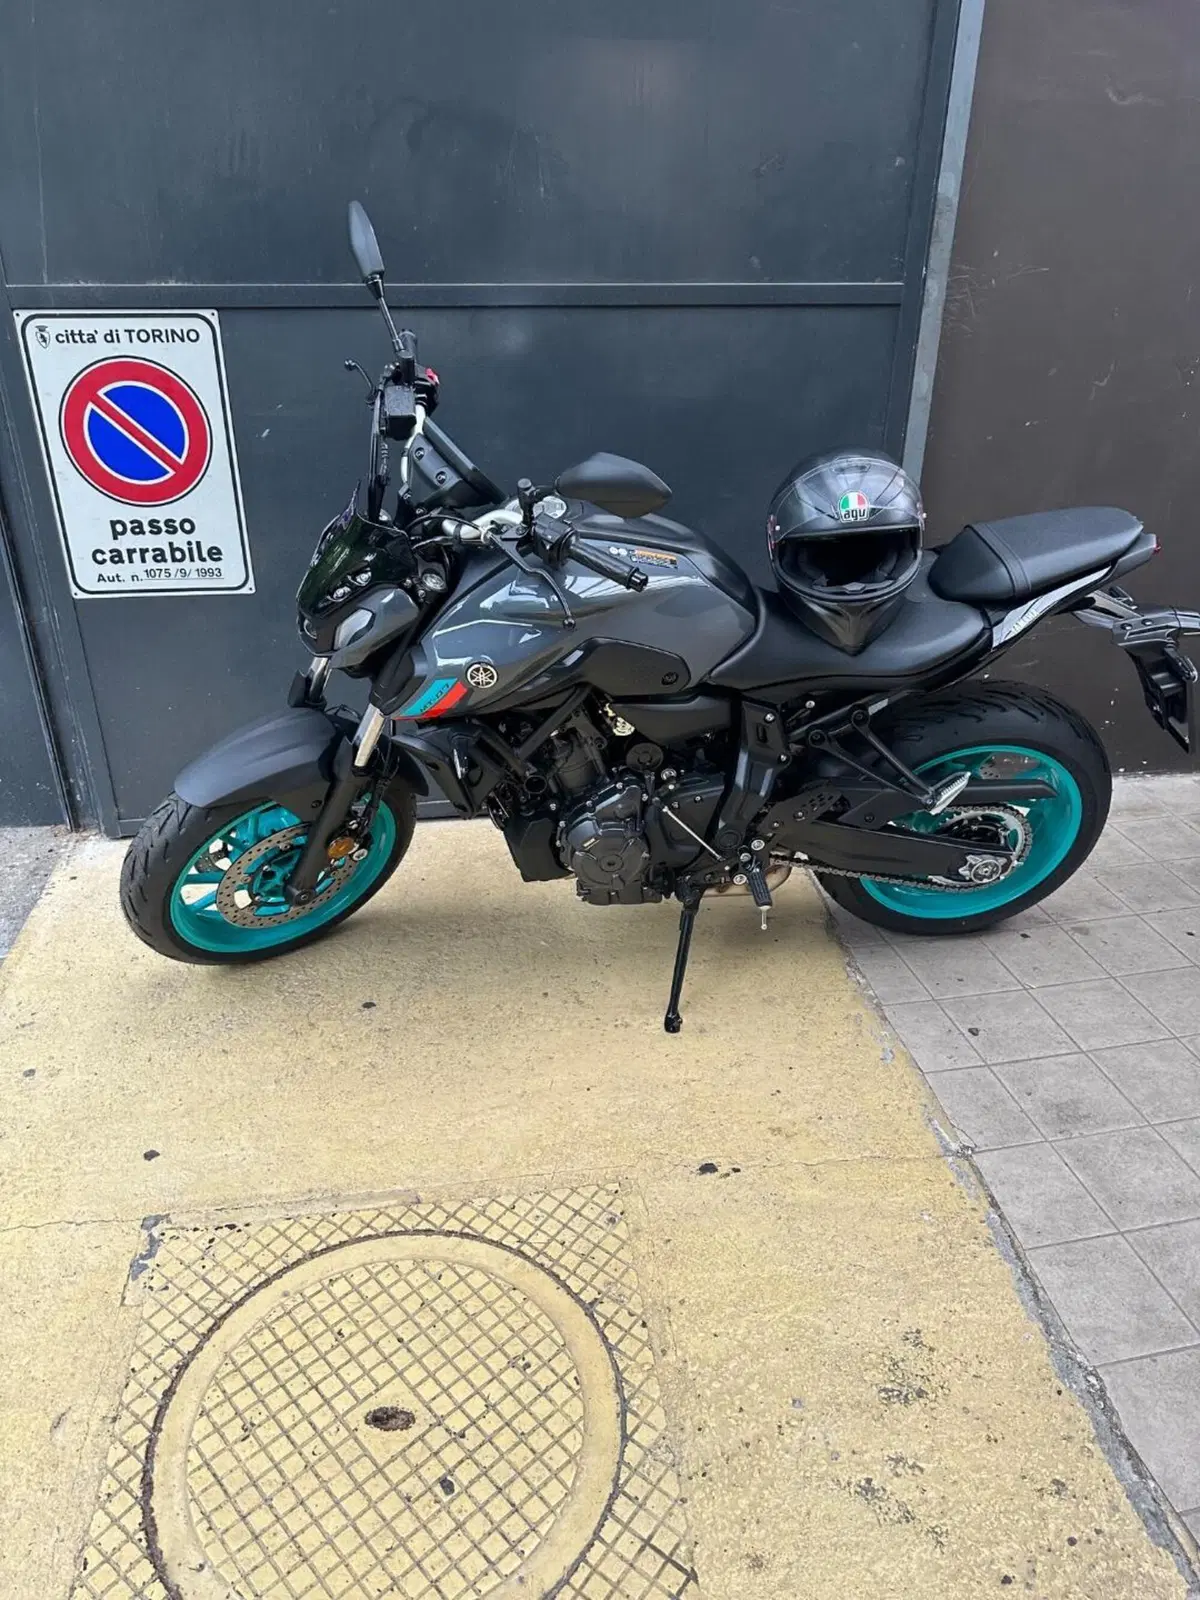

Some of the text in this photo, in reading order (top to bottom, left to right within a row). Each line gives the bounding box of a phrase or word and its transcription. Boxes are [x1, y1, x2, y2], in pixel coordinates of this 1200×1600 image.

[104, 329, 121, 344] di
[125, 328, 200, 343] TORINO
[110, 517, 195, 540] passo
[92, 541, 223, 565] carrabile
[97, 572, 125, 583] Aut.
[131, 573, 143, 582] n.
